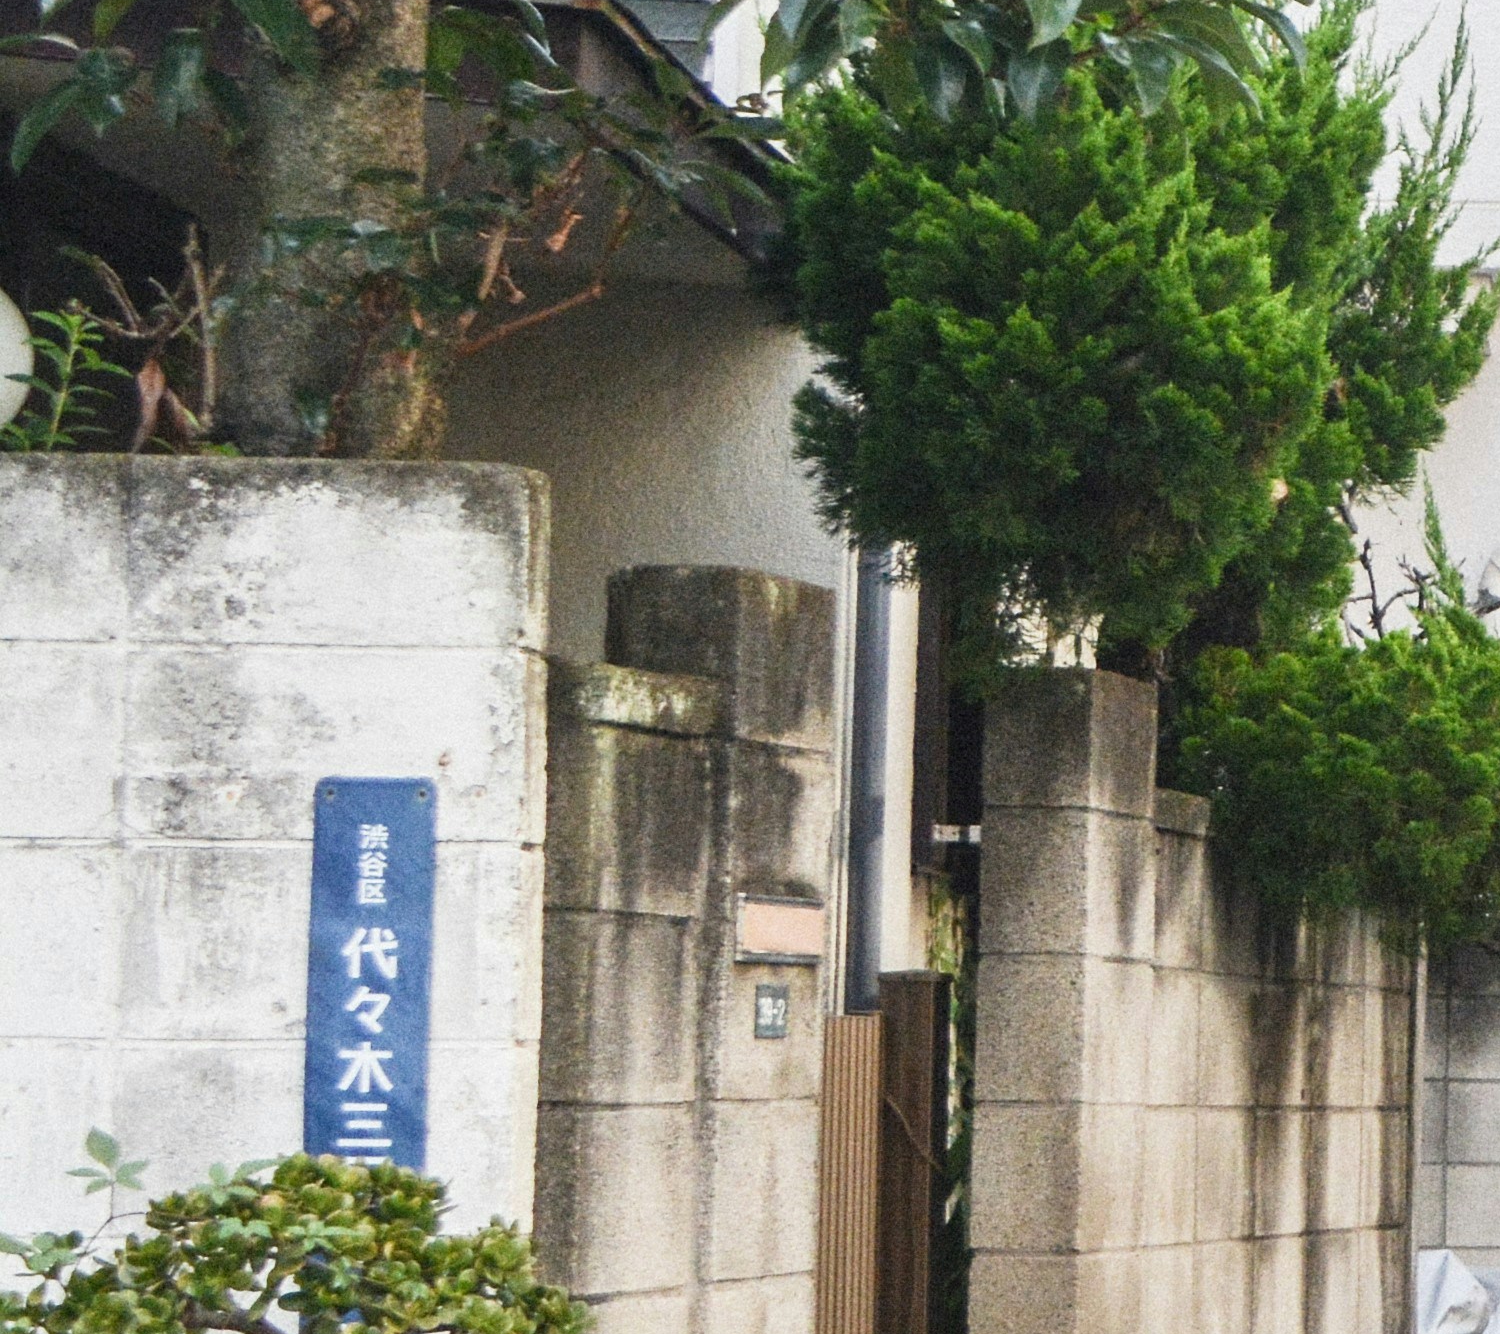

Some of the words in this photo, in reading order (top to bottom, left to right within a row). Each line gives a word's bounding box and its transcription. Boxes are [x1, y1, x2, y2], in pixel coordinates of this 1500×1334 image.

[358, 822, 390, 905] 渋谷区
[337, 926, 399, 1166] 代々木三
